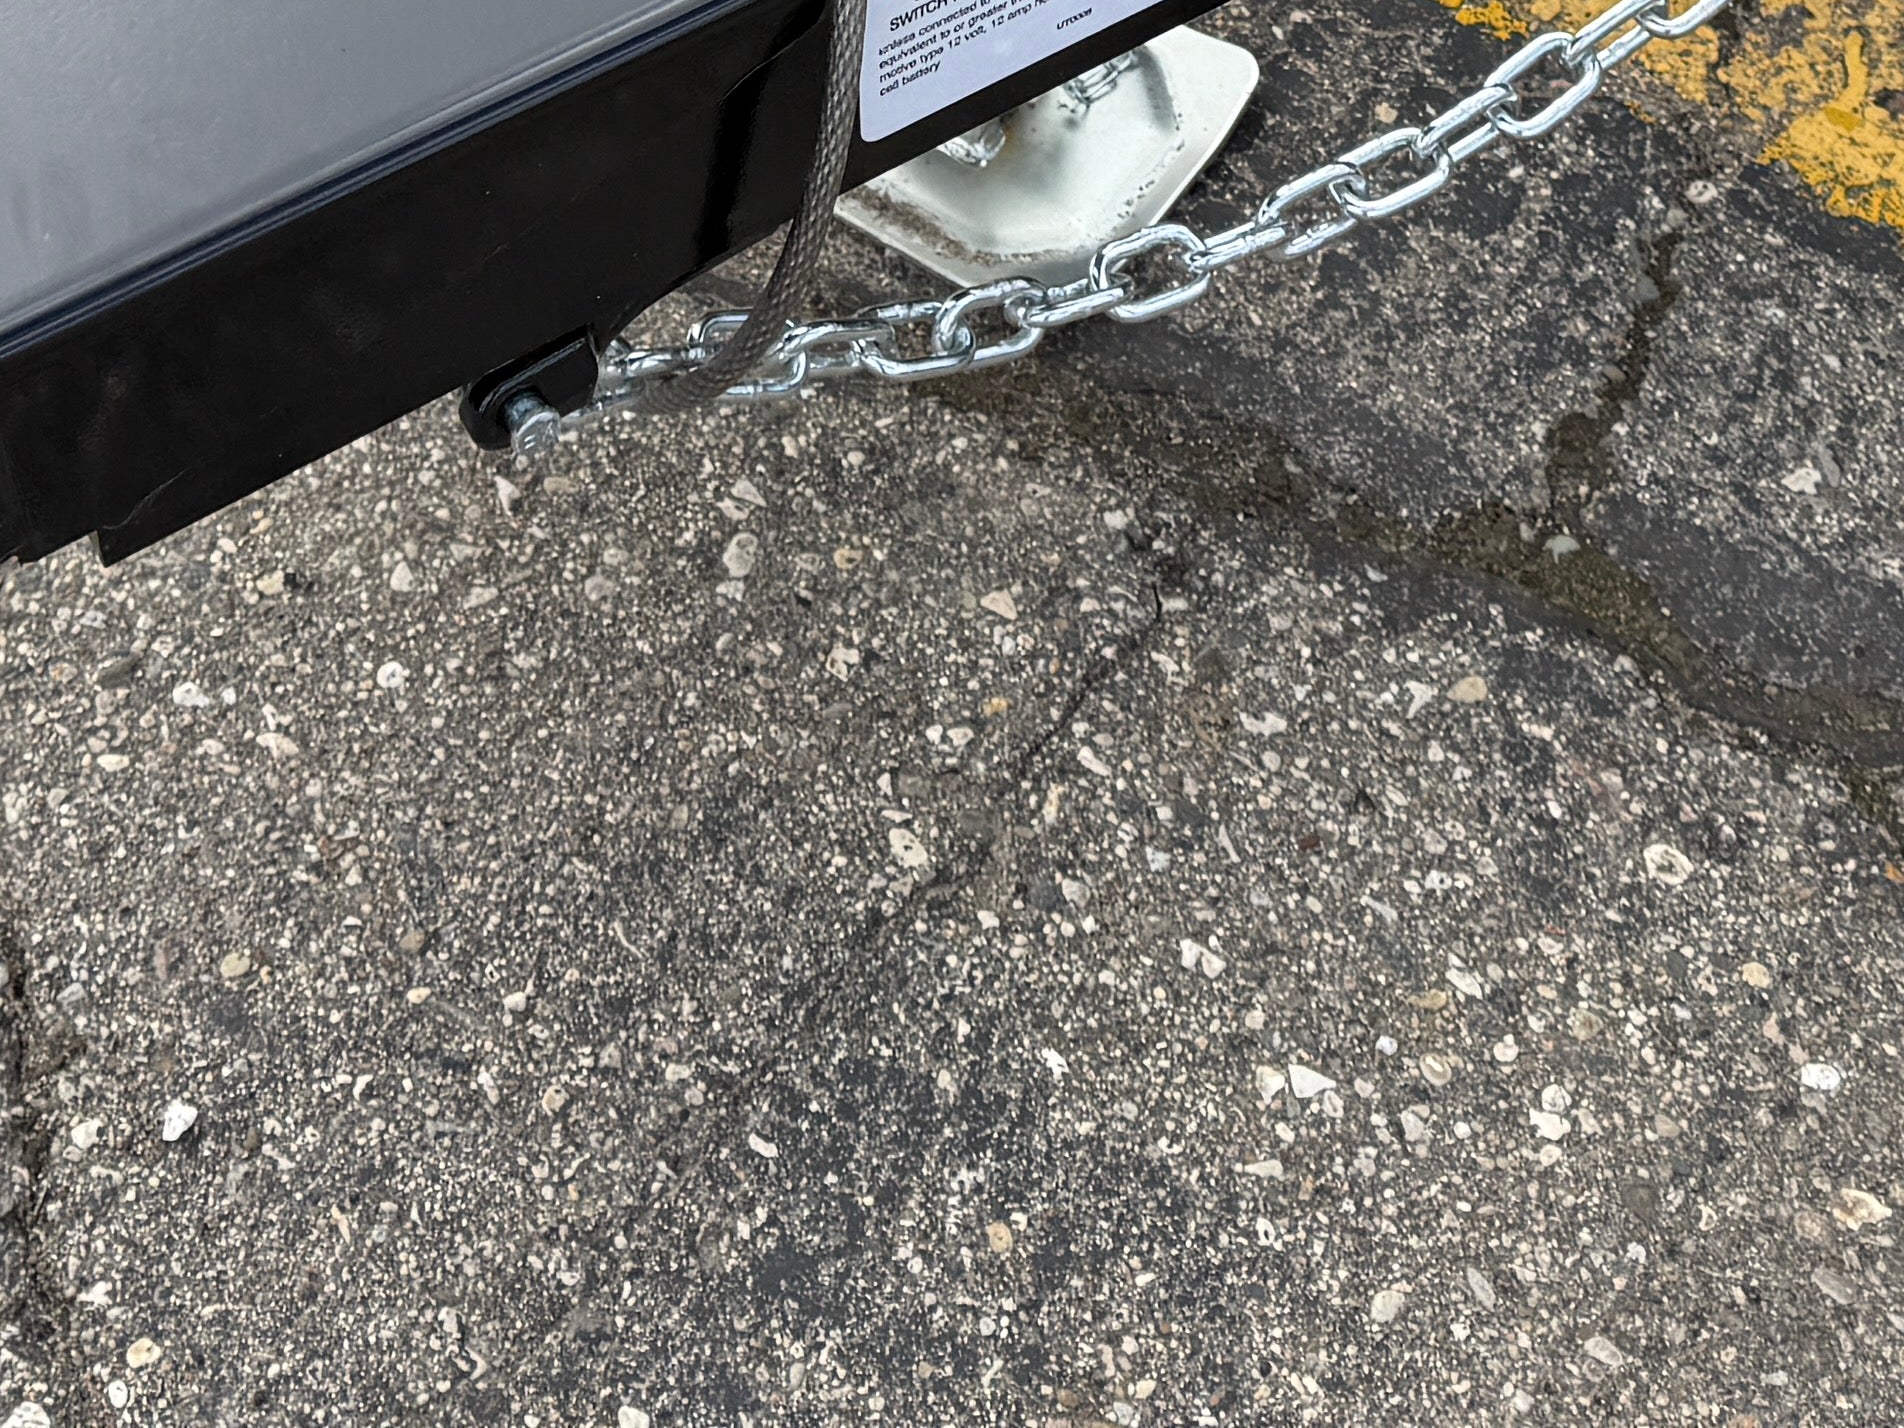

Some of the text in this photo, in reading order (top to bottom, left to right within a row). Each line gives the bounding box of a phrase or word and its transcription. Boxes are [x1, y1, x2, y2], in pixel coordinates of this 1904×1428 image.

[879, 33, 936, 70] equivalent
[940, 28, 949, 39] to
[953, 22, 964, 33] or
[968, 0, 1007, 28] greater
[919, 1, 976, 37] connected
[920, 44, 943, 65] type
[949, 35, 959, 50] 12
[991, 14, 1004, 29] 12
[1007, 3, 1031, 23] amp
